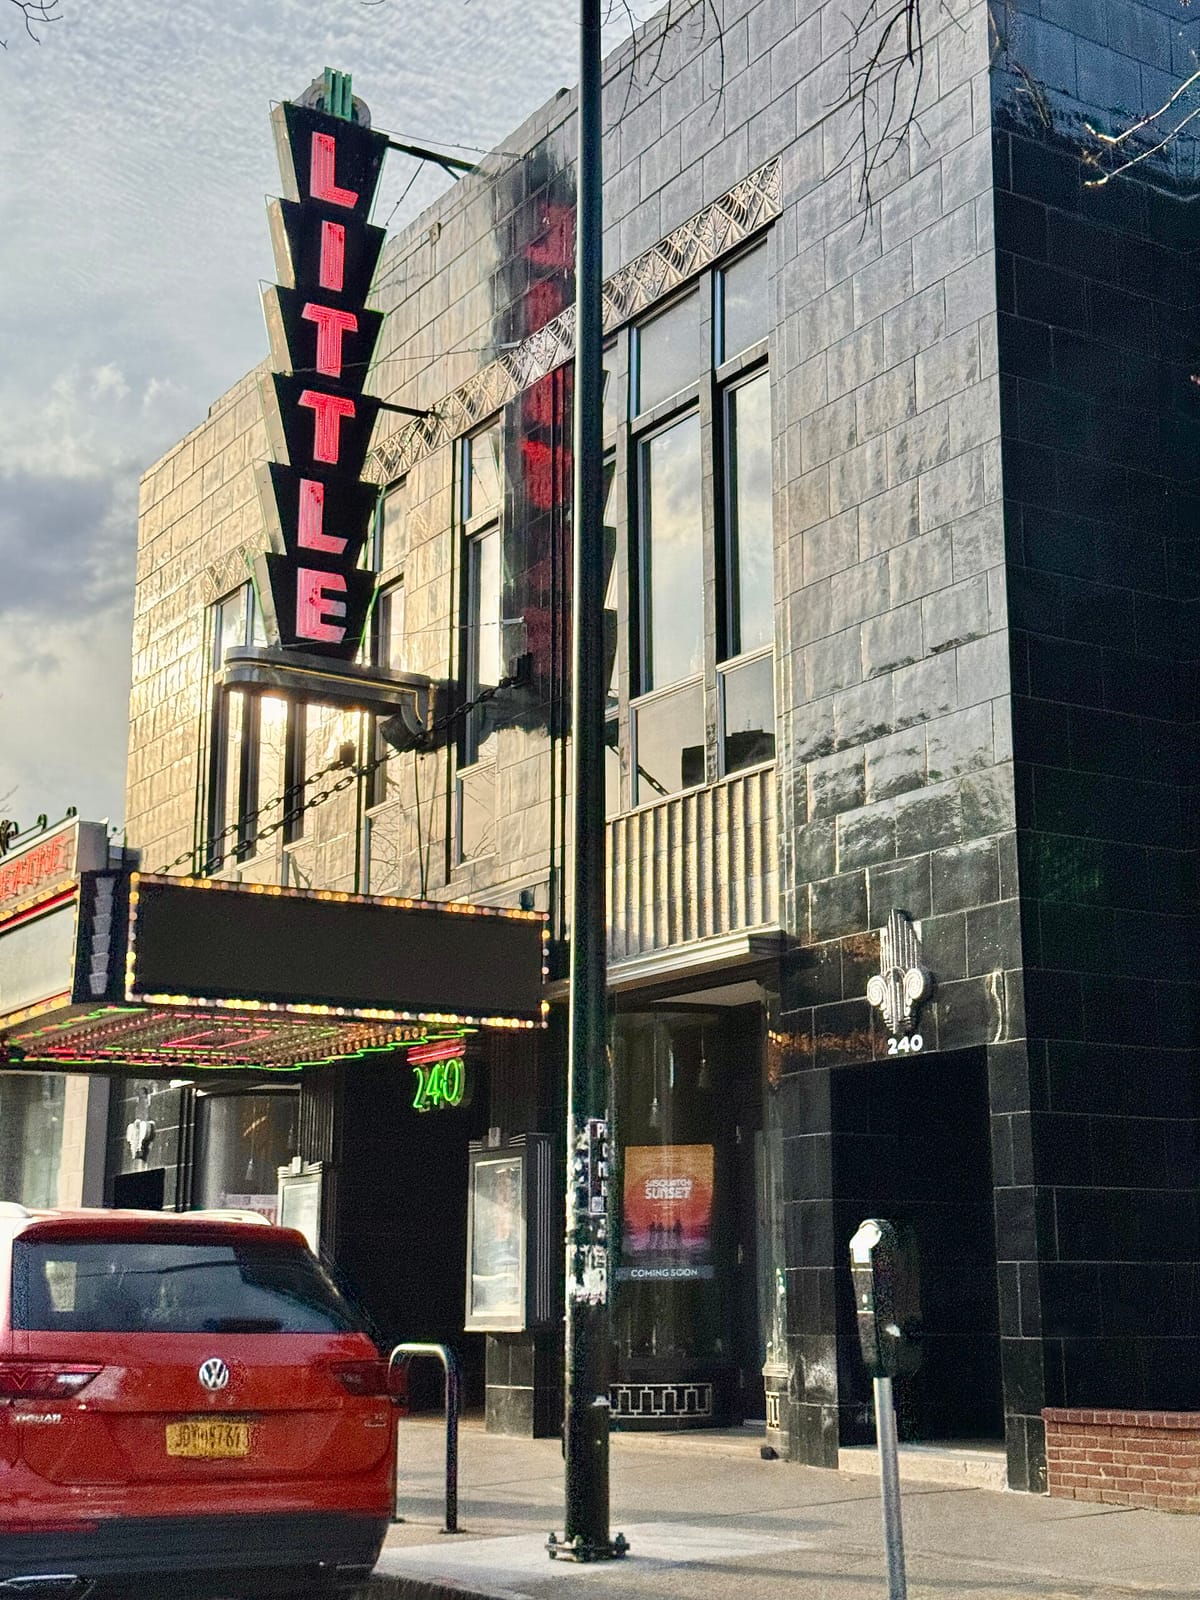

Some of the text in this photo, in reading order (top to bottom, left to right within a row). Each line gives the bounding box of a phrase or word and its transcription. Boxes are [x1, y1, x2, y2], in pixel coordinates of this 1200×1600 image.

[295, 130, 360, 645] LITTLE
[887, 1034, 924, 1055] 240
[412, 1058, 466, 1112] 240
[645, 1187, 691, 1200] SUNSET
[630, 1268, 698, 1278] COMING SOON
